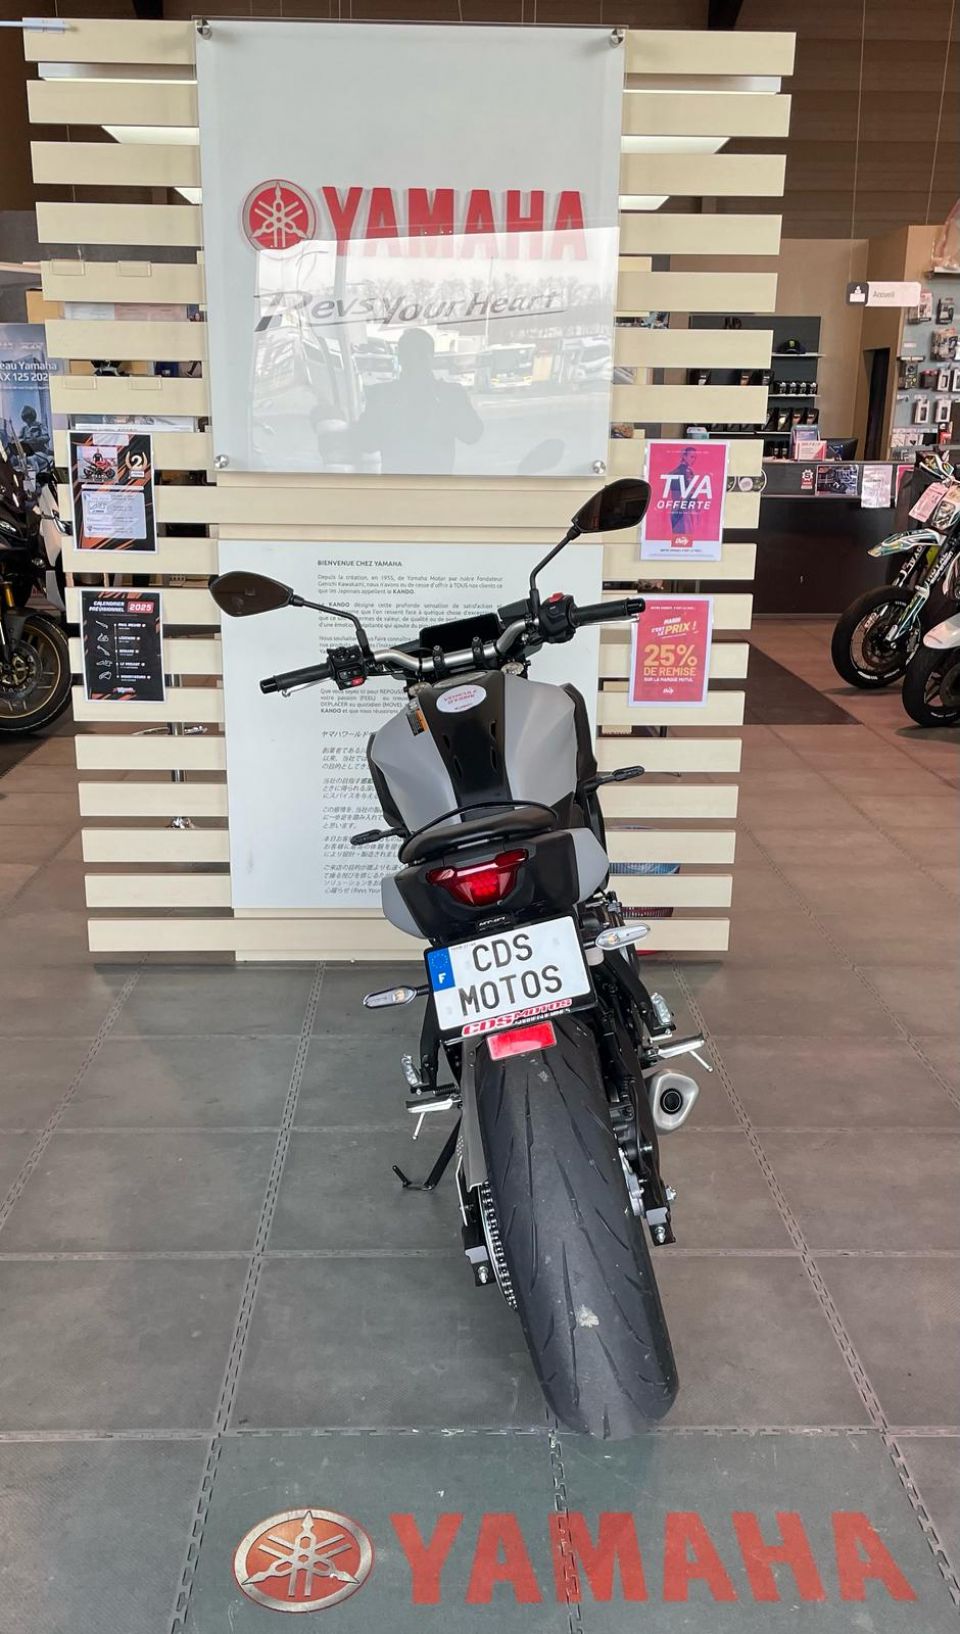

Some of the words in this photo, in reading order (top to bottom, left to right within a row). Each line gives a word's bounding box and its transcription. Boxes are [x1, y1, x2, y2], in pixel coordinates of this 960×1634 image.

[321, 186, 588, 260] YAMAHA
[254, 292, 375, 332] Revs
[380, 294, 459, 326] Your
[465, 291, 563, 317] Heart
[12, 372, 29, 381] 125
[31, 372, 48, 381] 202
[18, 361, 57, 370] Yamaha
[131, 455, 142, 469] 2
[660, 474, 712, 499] TVA
[657, 500, 711, 510] OFFERTE
[129, 603, 152, 612] 2025
[664, 621, 691, 635] PRIX
[643, 644, 698, 666] 25%
[643, 667, 657, 676] DE
[659, 667, 696, 676] REMISE
[471, 933, 533, 972] CDS
[438, 972, 447, 984] F
[458, 965, 563, 1016] MOTOS
[463, 1015, 513, 1036] CDS
[513, 1000, 571, 1020] MOTOS
[390, 1512, 918, 1605] YAMAHA
